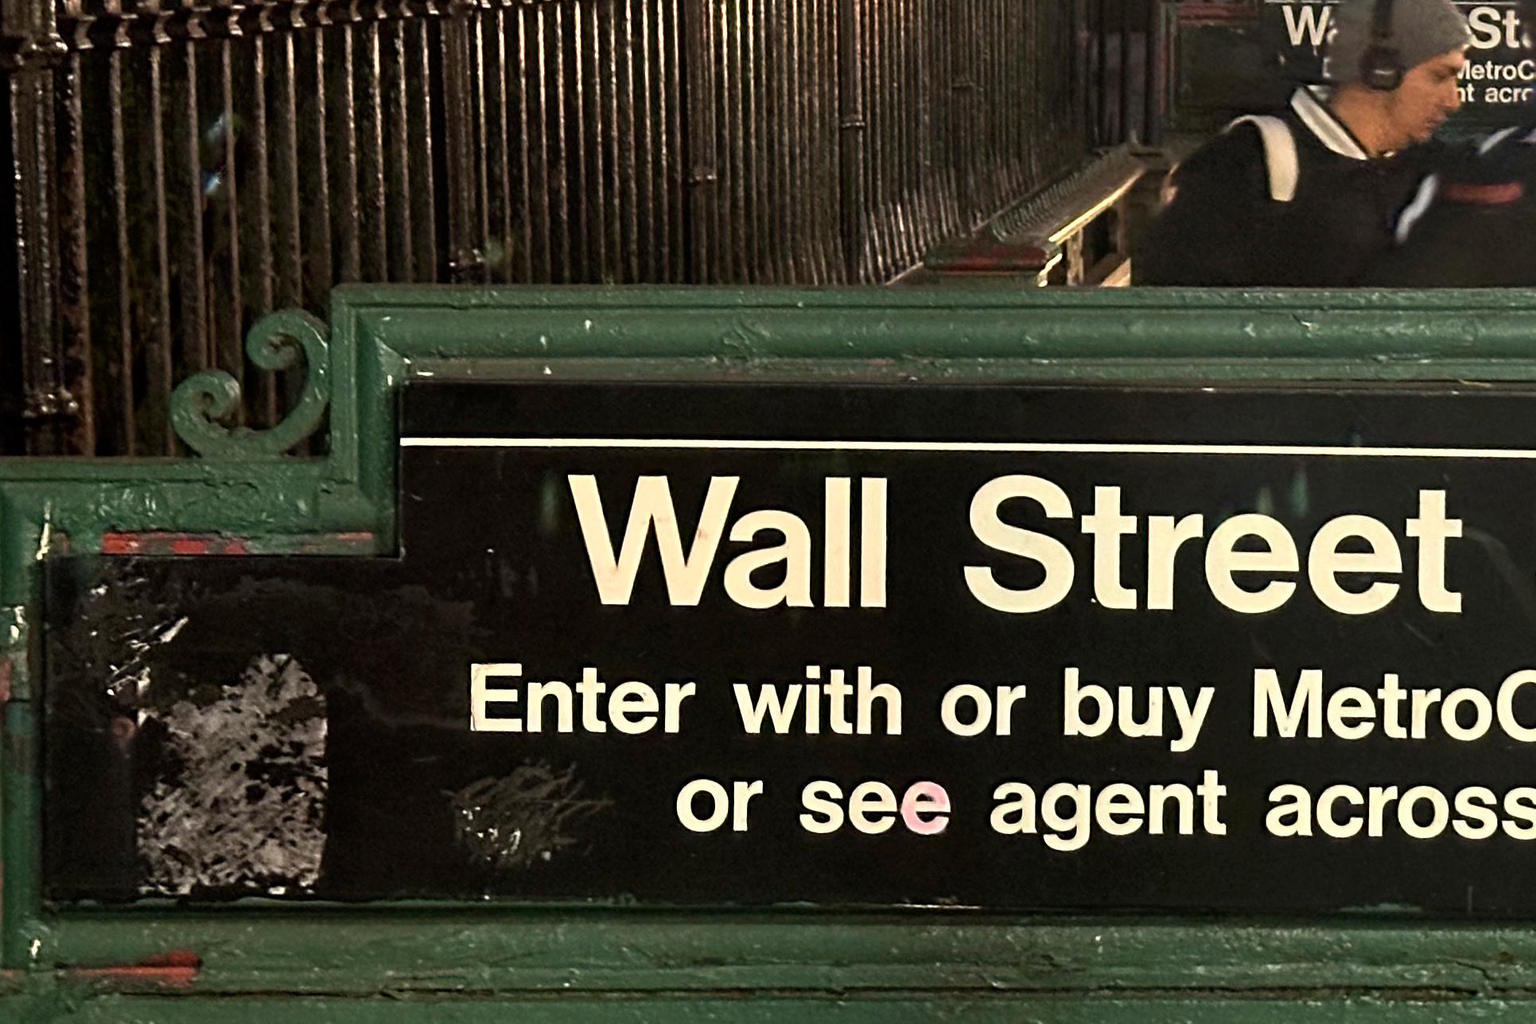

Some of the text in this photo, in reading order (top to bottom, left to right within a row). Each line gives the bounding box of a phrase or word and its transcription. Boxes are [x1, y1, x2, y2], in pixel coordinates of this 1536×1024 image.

[1467, 5, 1532, 49] St
[567, 474, 888, 609] Wall
[963, 474, 1463, 615] Street
[470, 662, 696, 735] Enter
[732, 665, 902, 735] with
[940, 683, 1027, 737] or
[1063, 667, 1215, 752] buy
[676, 778, 764, 833] or
[799, 780, 951, 836] see
[990, 770, 1227, 852] agent
